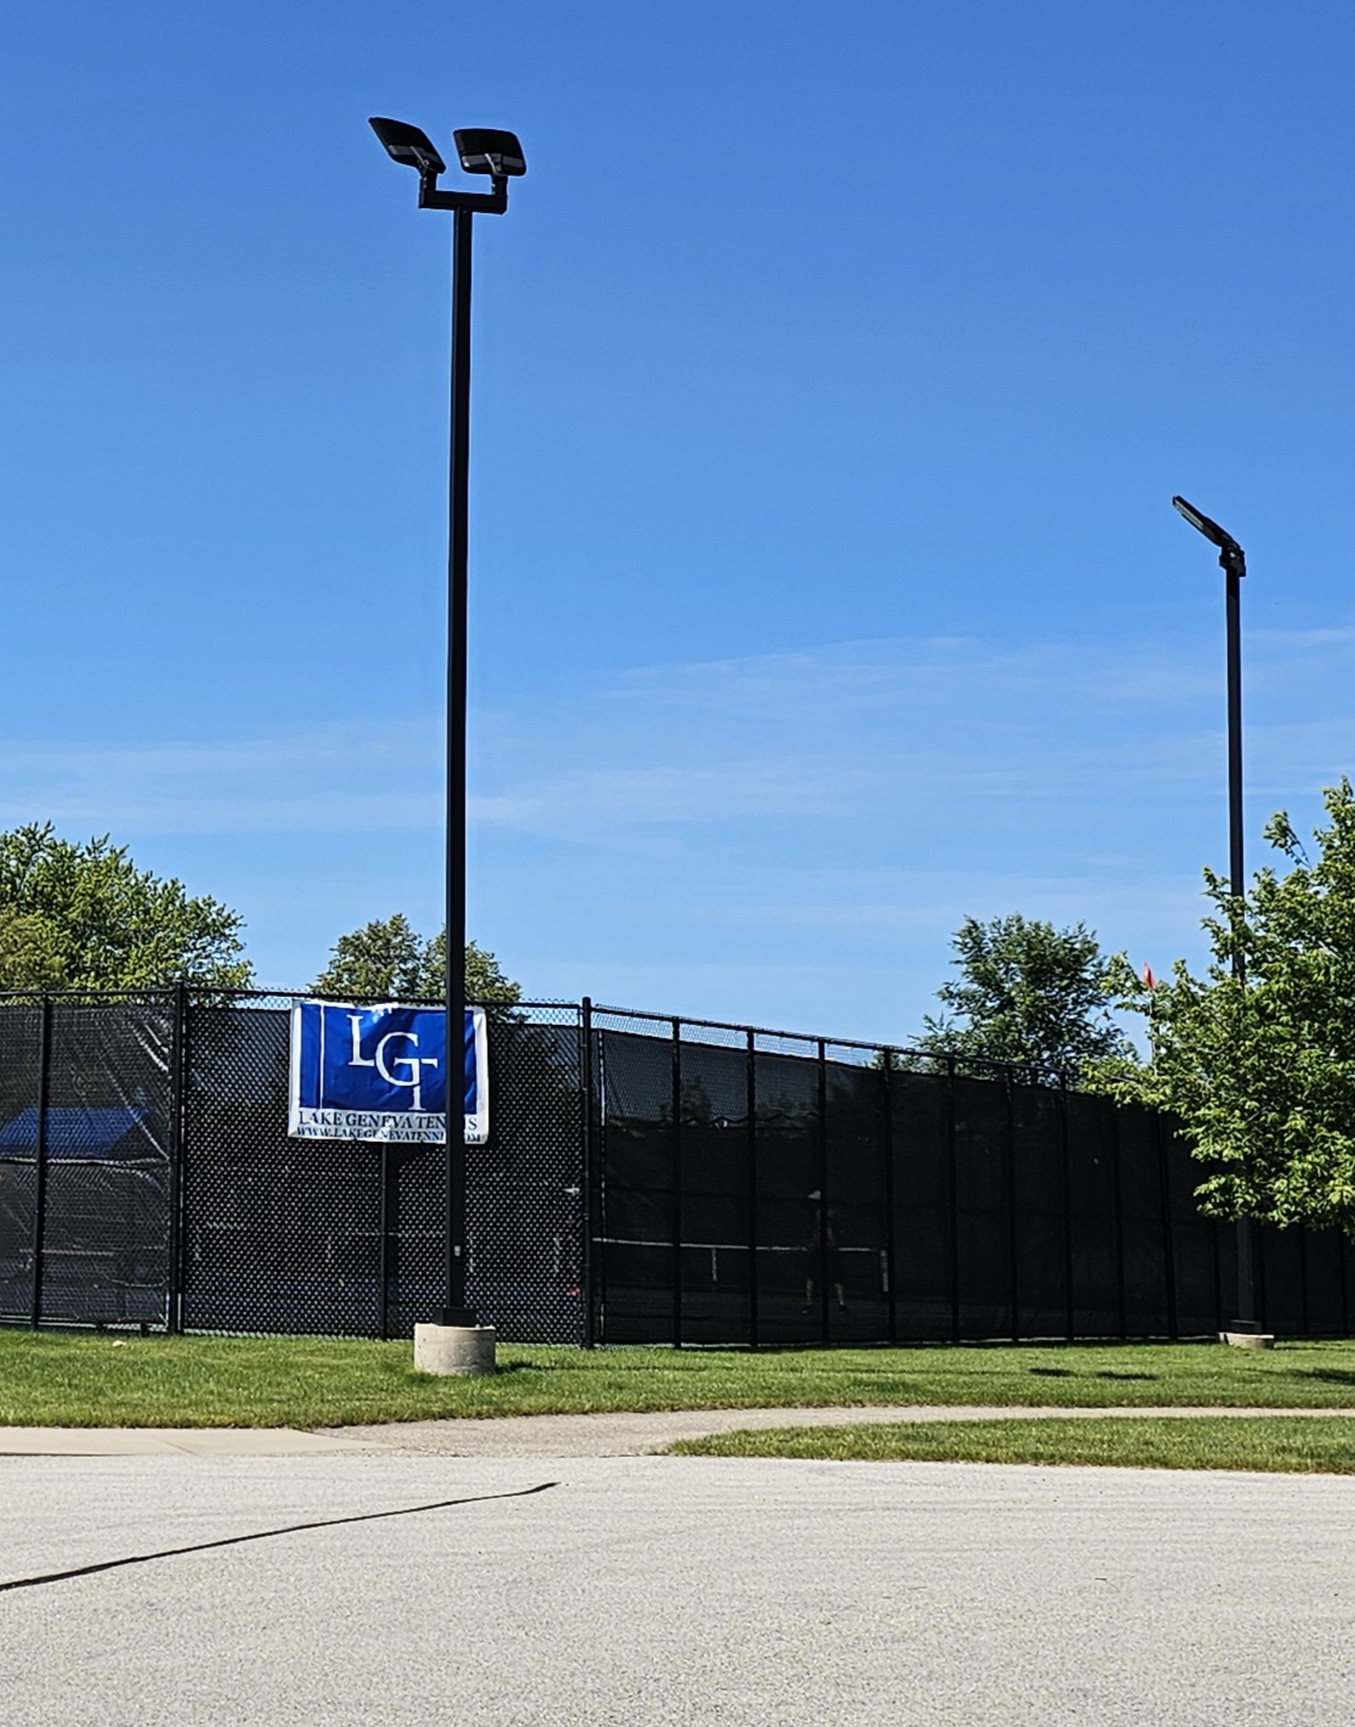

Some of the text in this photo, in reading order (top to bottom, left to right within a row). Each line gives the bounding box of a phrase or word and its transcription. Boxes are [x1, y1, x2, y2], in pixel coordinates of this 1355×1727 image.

[346, 1014, 438, 1111] LGT
[299, 1111, 478, 1131] LAKE GENEVA TENS
